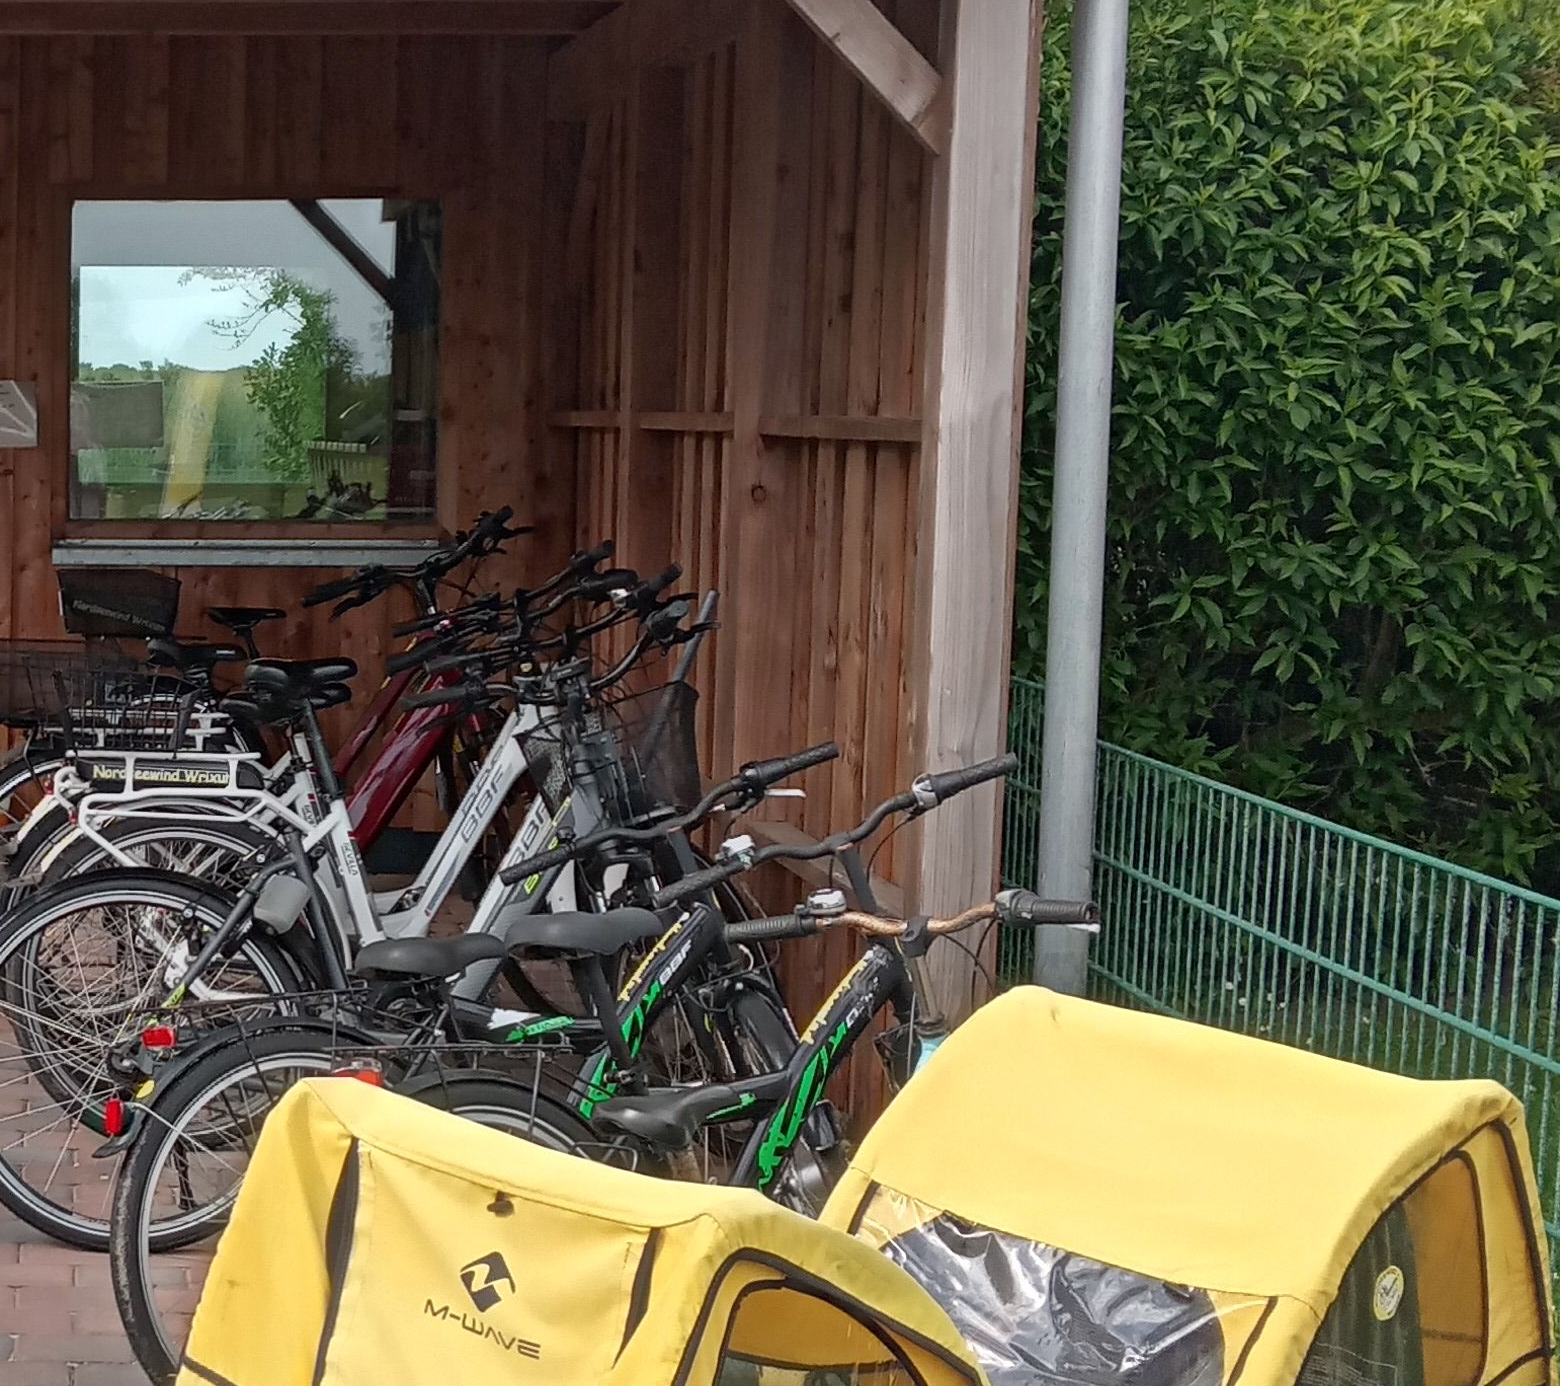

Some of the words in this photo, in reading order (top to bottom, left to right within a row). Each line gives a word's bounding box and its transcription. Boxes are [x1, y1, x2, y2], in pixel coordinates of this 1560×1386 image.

[184, 769, 231, 784] Wrixu
[460, 764, 504, 844] BBF
[424, 1298, 541, 1360] M-WAVE
